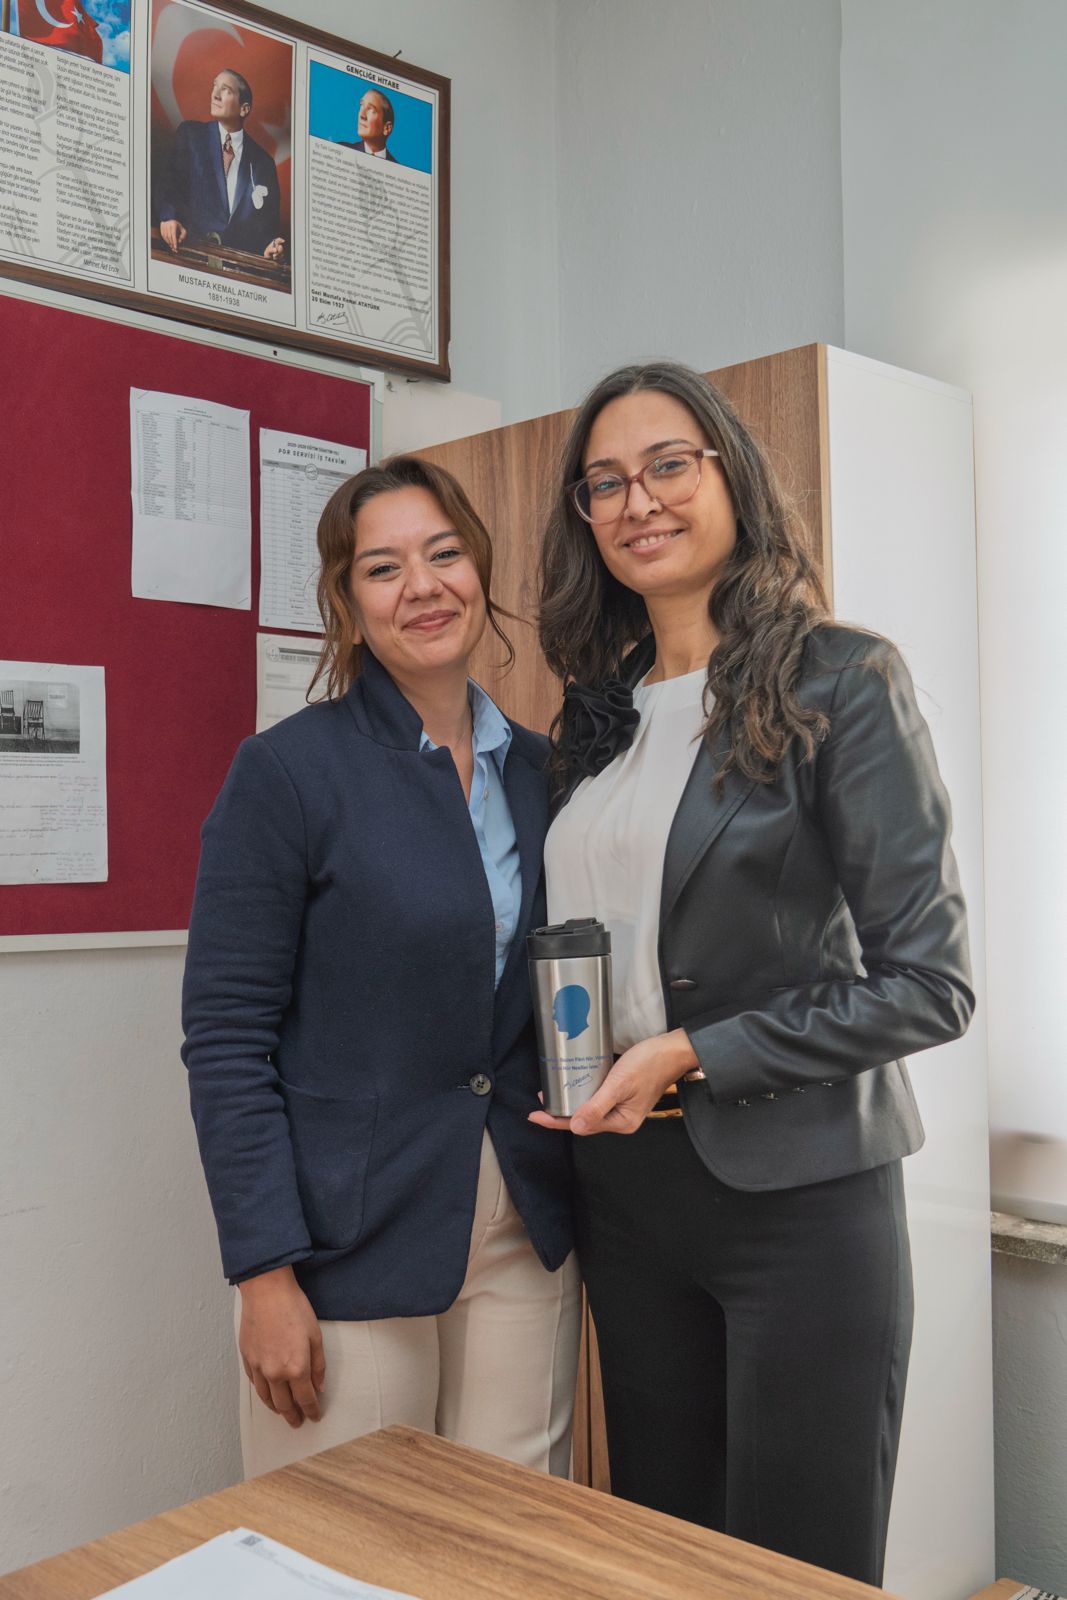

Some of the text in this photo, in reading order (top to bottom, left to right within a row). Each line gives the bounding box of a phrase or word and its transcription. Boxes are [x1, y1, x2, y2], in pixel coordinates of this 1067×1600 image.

[178, 274, 268, 304] MUSTAFA KEMAL ATATÜRK
[208, 292, 241, 307] 1881-1938
